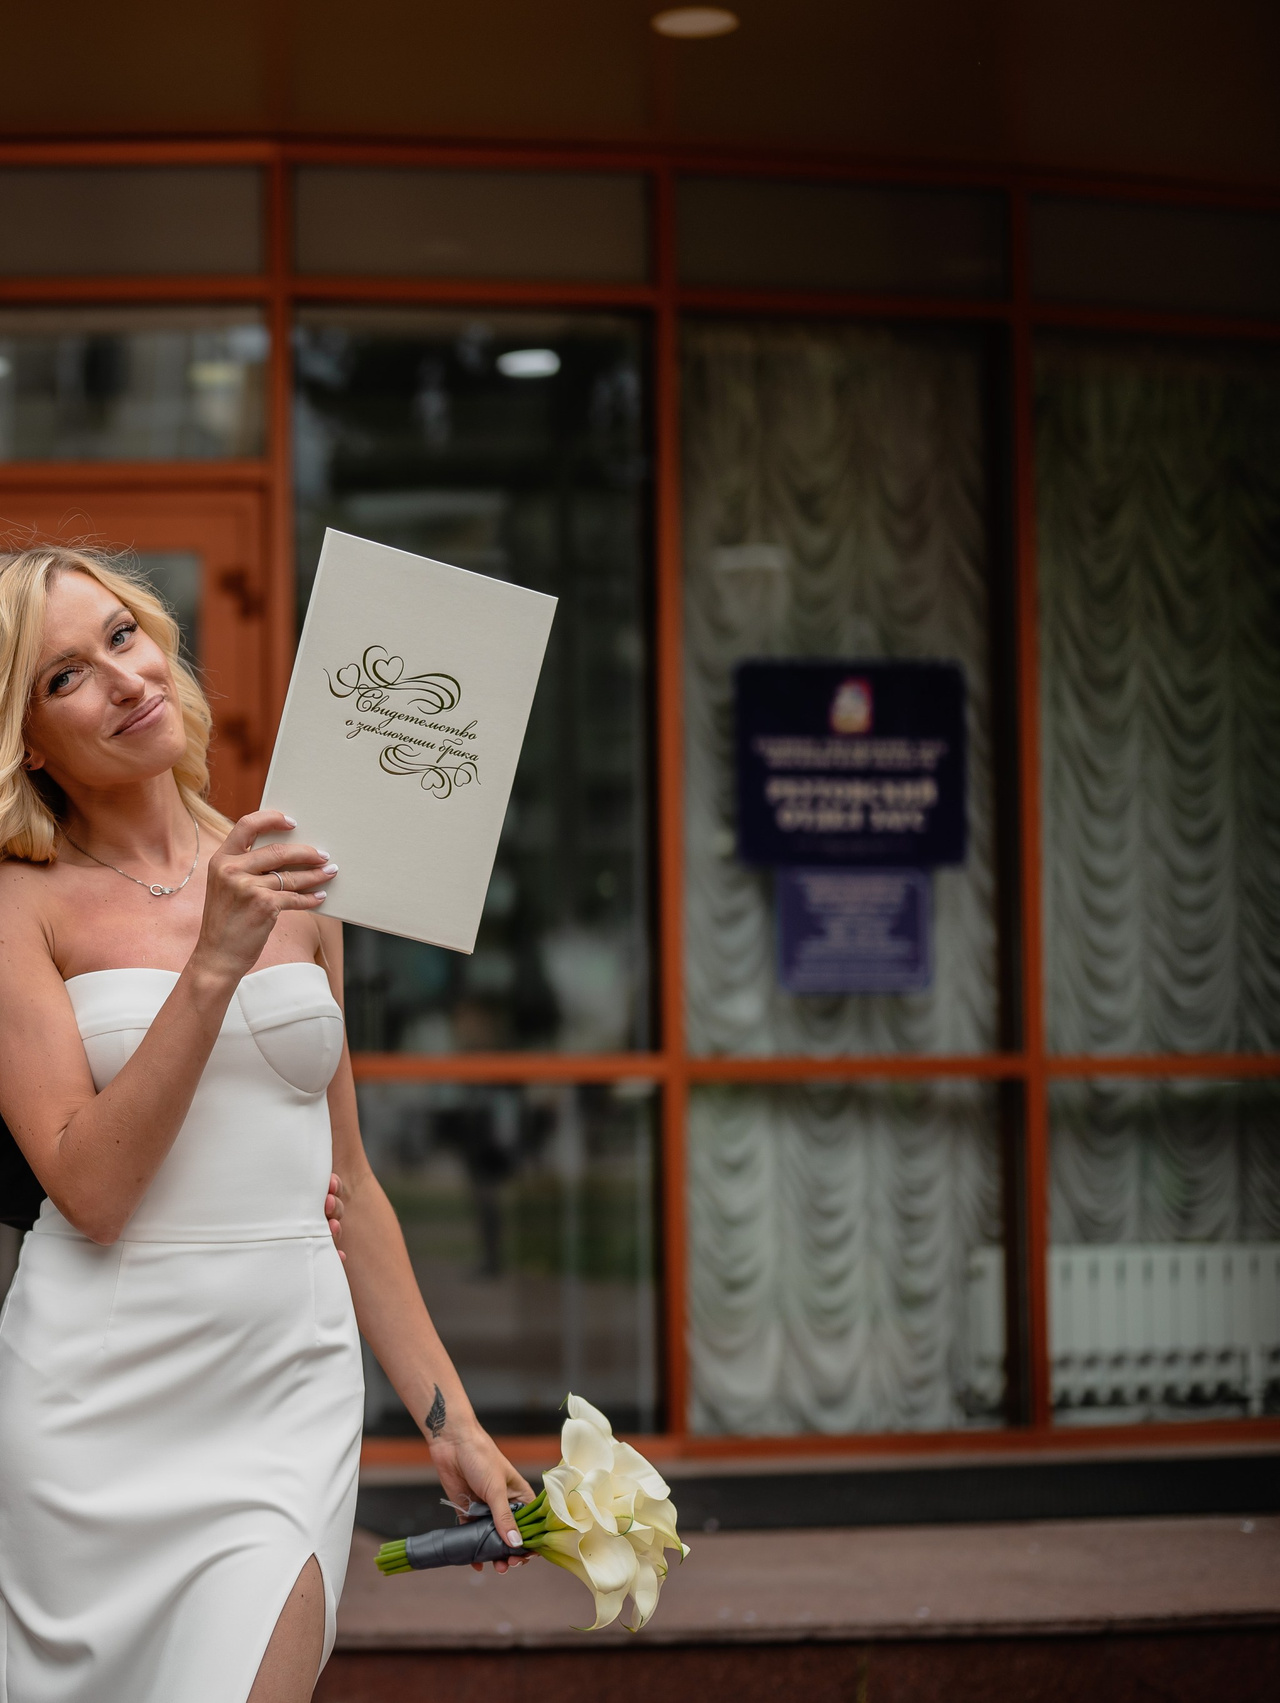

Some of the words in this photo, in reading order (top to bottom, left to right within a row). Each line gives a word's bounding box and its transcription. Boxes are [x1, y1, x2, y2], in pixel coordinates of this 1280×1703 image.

[356, 684, 477, 740] Свидетельство
[346, 722, 436, 749] заключении
[435, 738, 479, 763] брака
